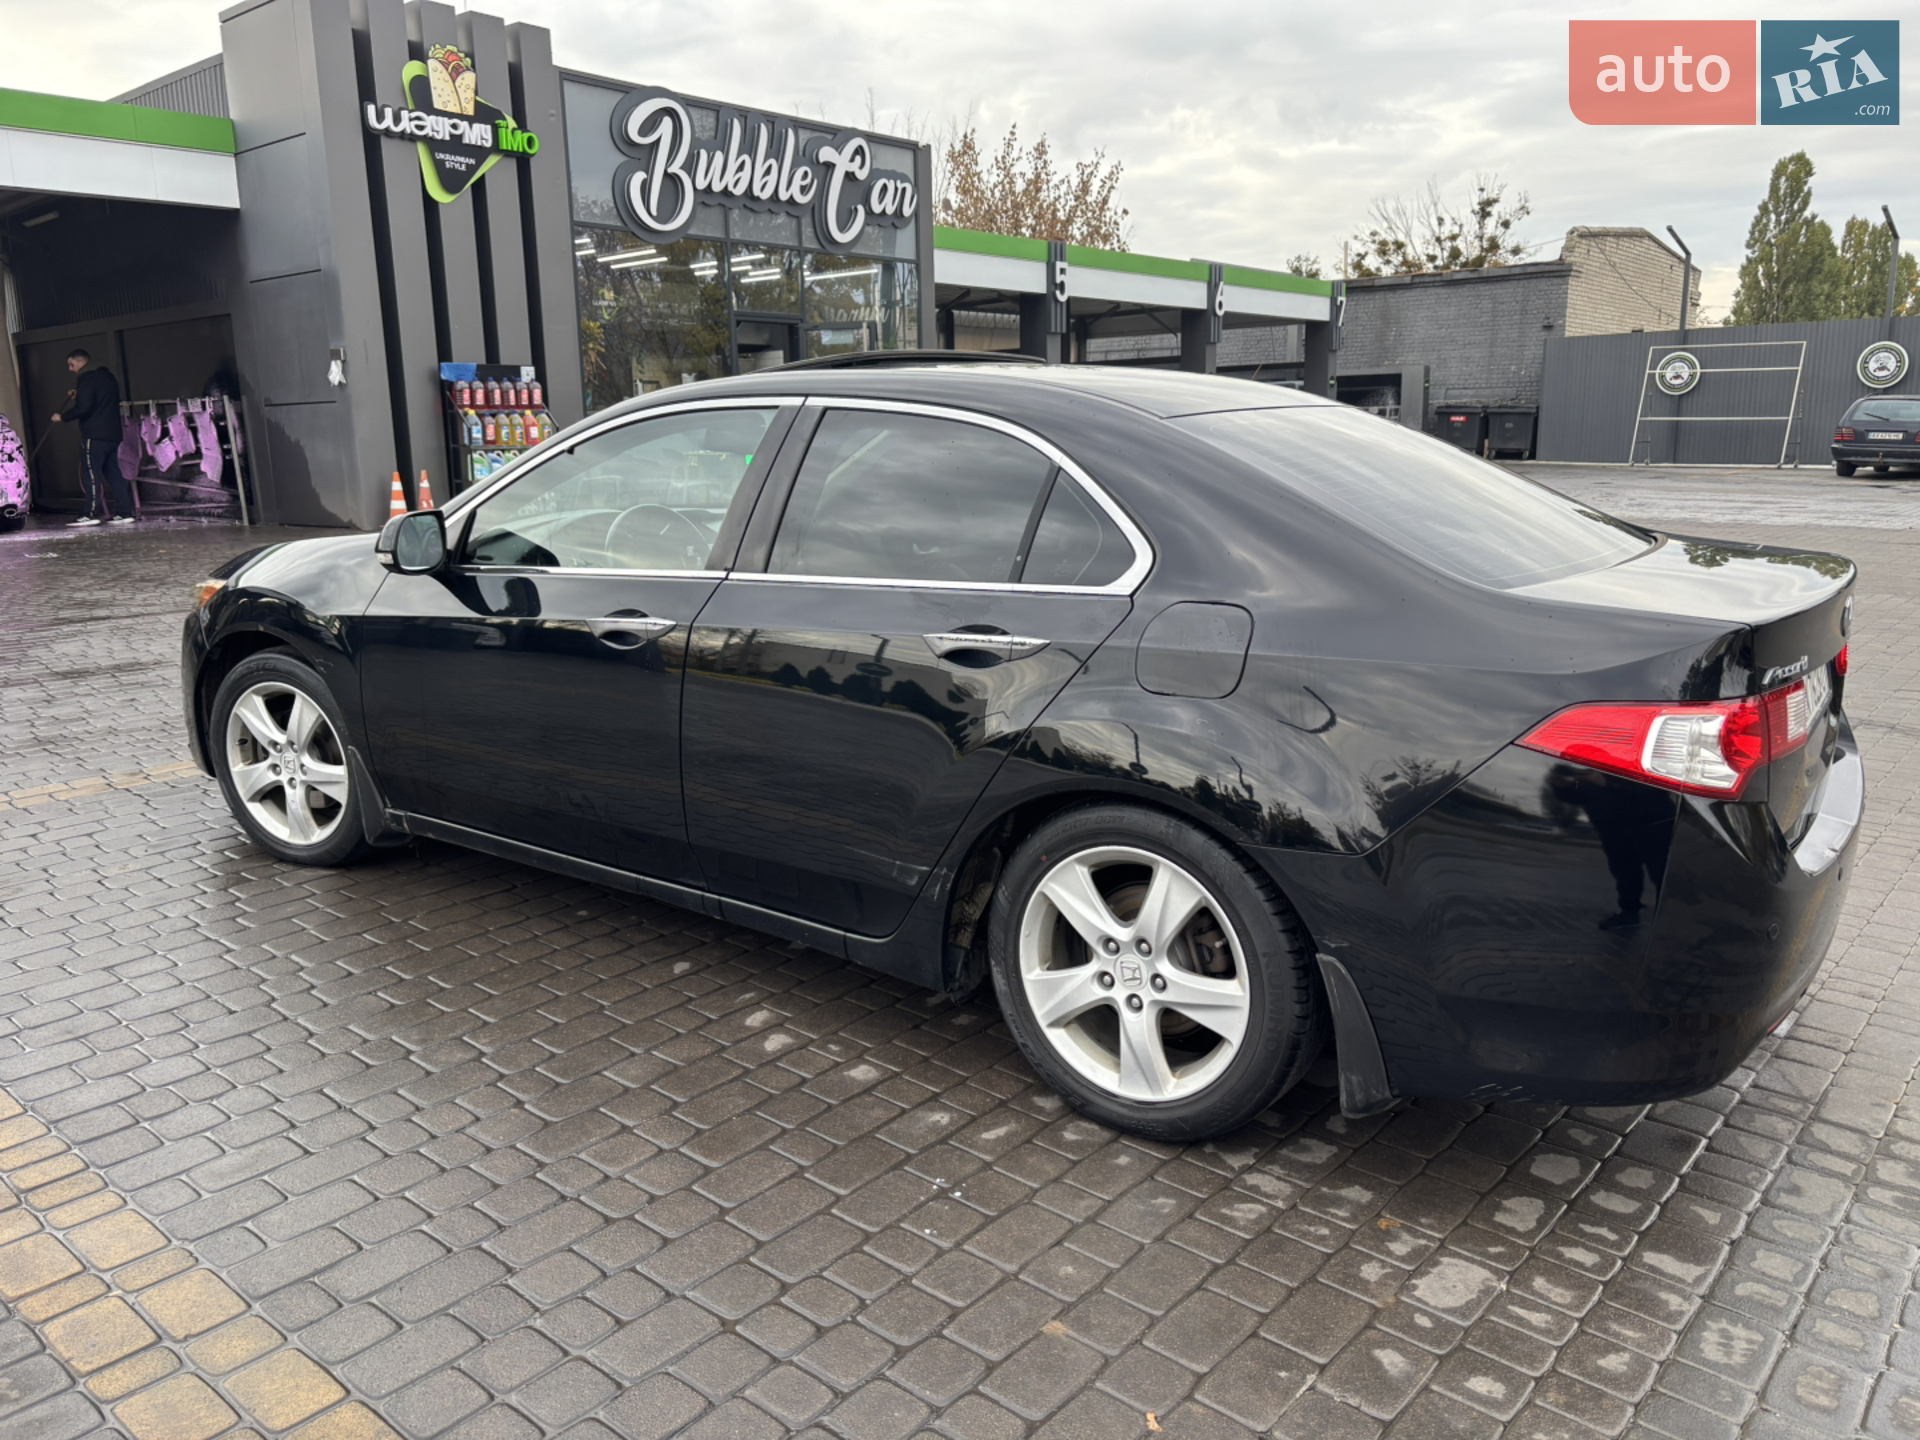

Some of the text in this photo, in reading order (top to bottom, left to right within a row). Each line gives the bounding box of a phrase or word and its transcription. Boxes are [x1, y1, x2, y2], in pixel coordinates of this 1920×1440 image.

[434, 151, 476, 165] UKRAINIAN
[444, 160, 468, 172] STYLE
[623, 96, 918, 244] Bubble Car
[1054, 261, 1068, 303] 5
[1214, 281, 1226, 317] 6
[1336, 296, 1347, 328] 7
[1262, 948, 1286, 1051] KUMHO
